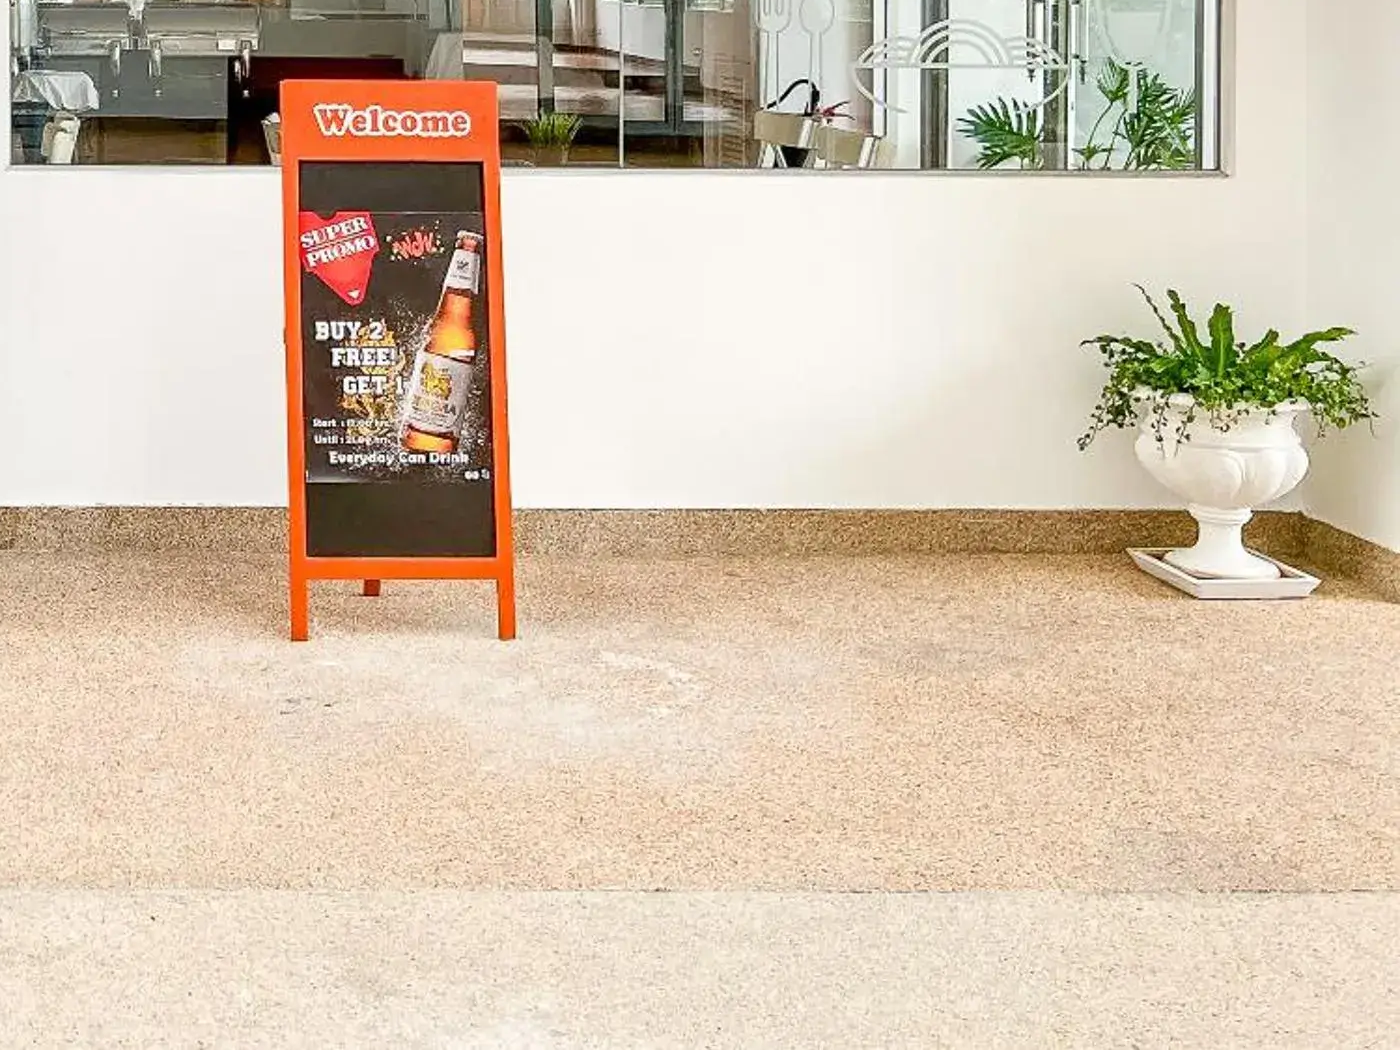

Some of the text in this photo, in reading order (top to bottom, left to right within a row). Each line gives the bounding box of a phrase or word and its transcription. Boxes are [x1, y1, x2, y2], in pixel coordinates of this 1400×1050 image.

[314, 104, 470, 137] Welcome
[300, 217, 369, 248] SUPER
[305, 236, 375, 267] PROMO
[315, 321, 384, 340] BUY 2
[331, 347, 396, 367] FREE!
[343, 375, 403, 395] GET 1
[313, 418, 336, 427] Start
[314, 435, 338, 444] Until
[329, 450, 469, 465] Everyday Can Drink
